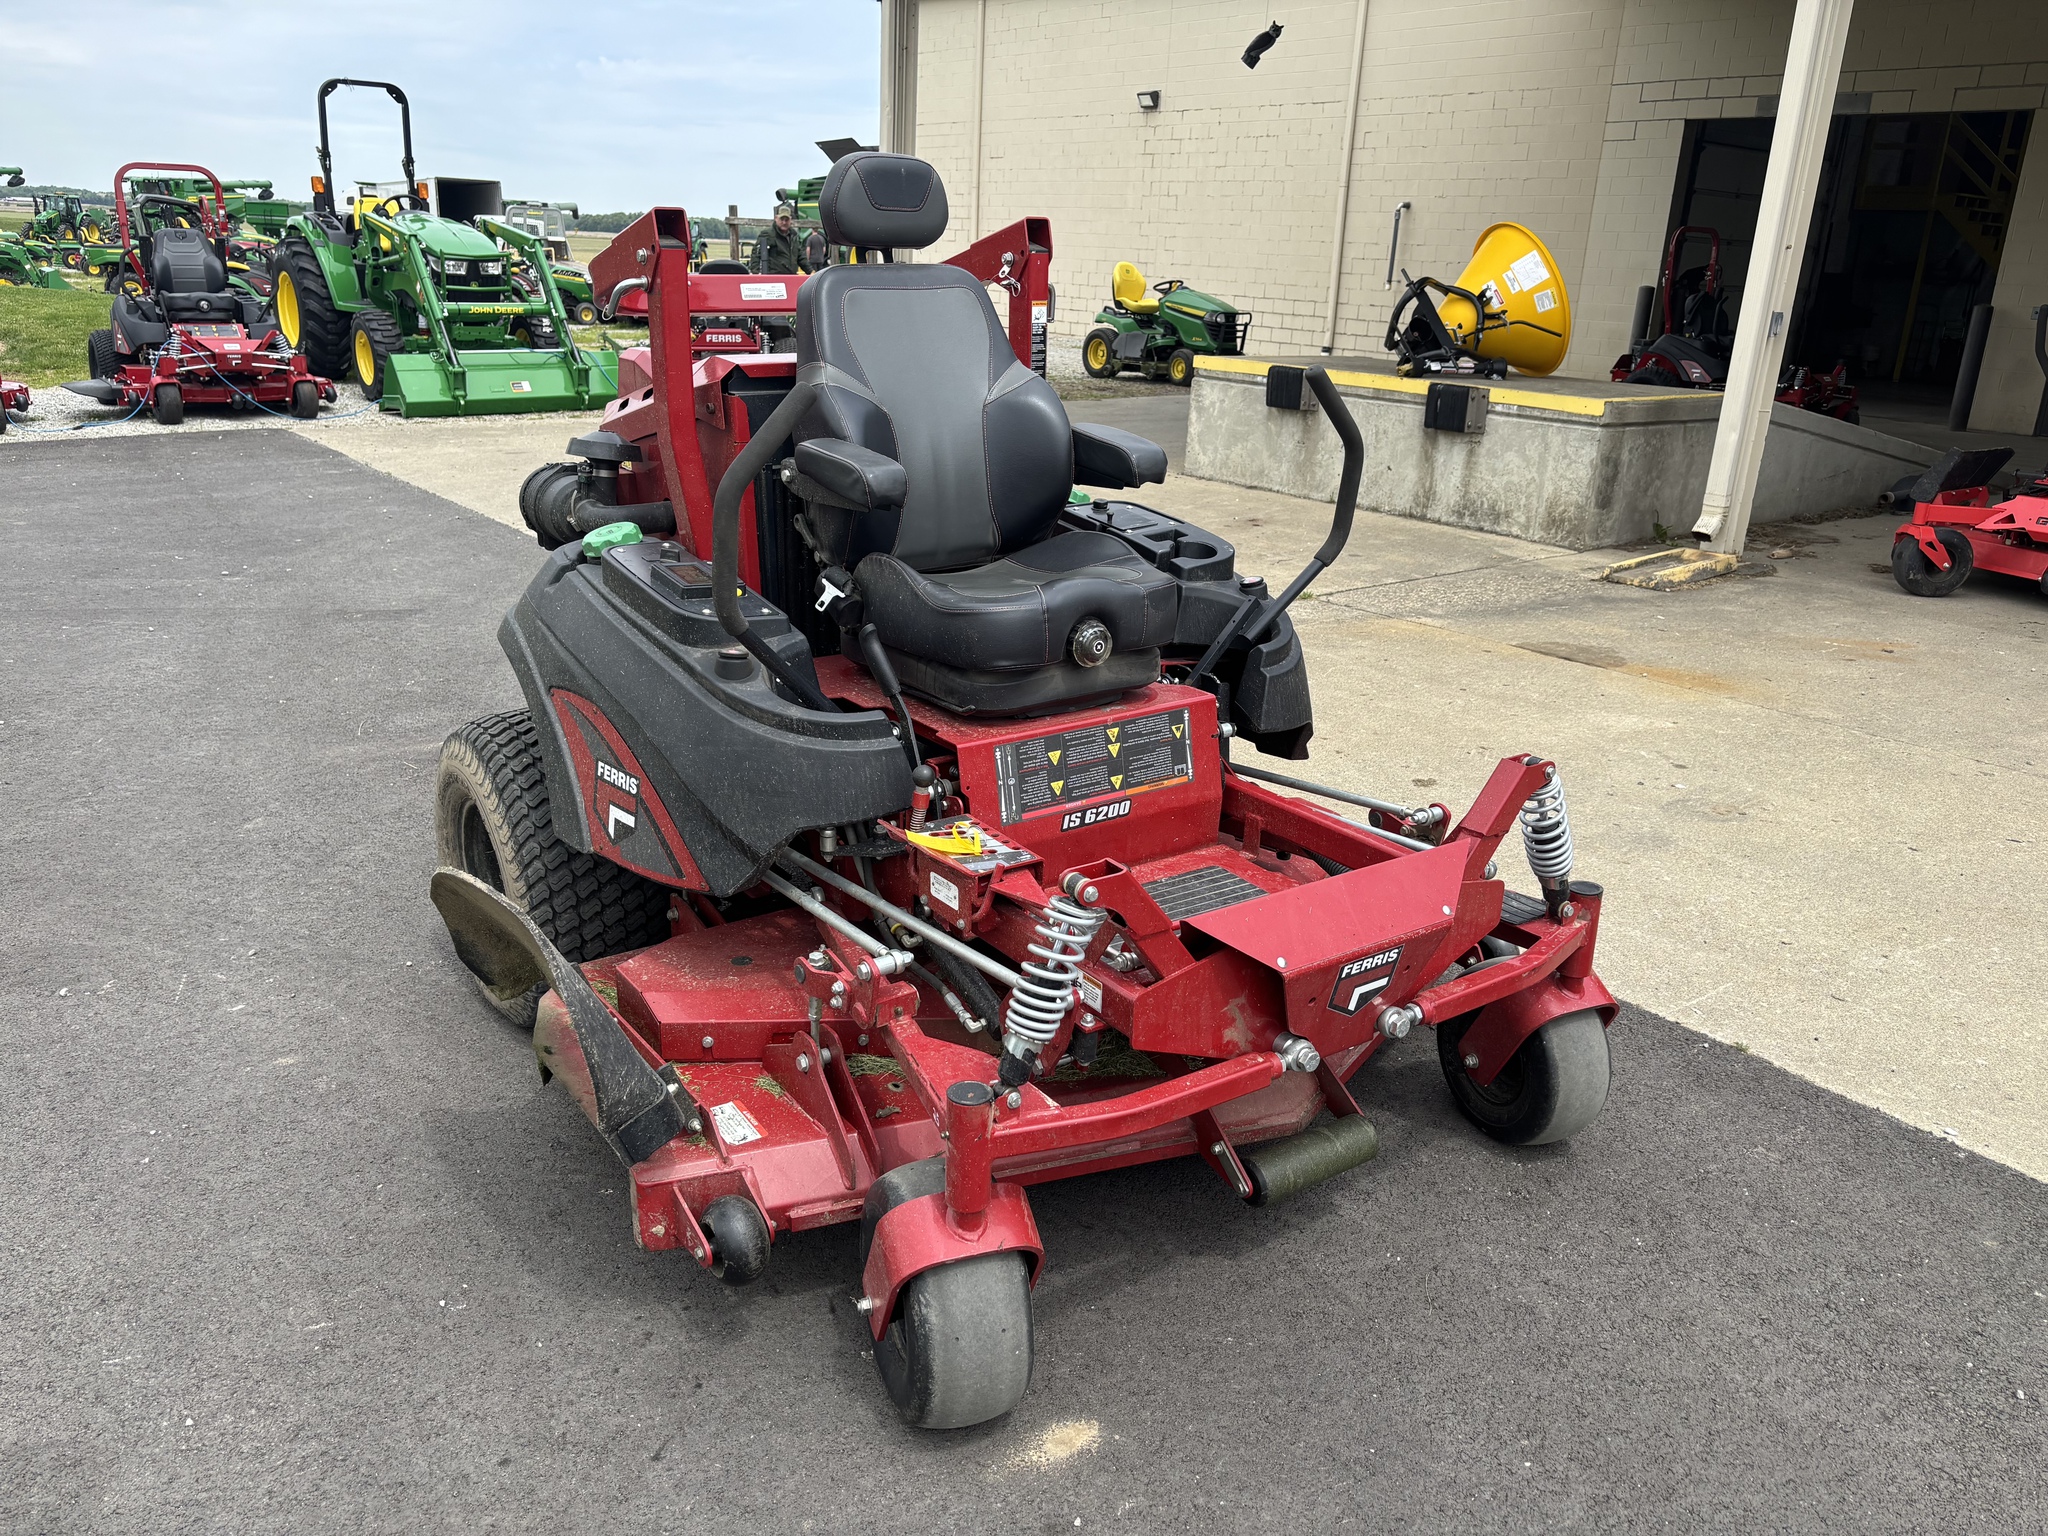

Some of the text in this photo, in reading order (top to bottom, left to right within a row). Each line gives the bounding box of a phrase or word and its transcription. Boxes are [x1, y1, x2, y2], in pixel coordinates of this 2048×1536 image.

[469, 306, 524, 314] JOHN DEERE
[706, 334, 742, 343] FERRIS
[597, 760, 639, 795] FERRIS
[1062, 800, 1131, 830] IS 6200
[1341, 948, 1399, 979] FERRIS
